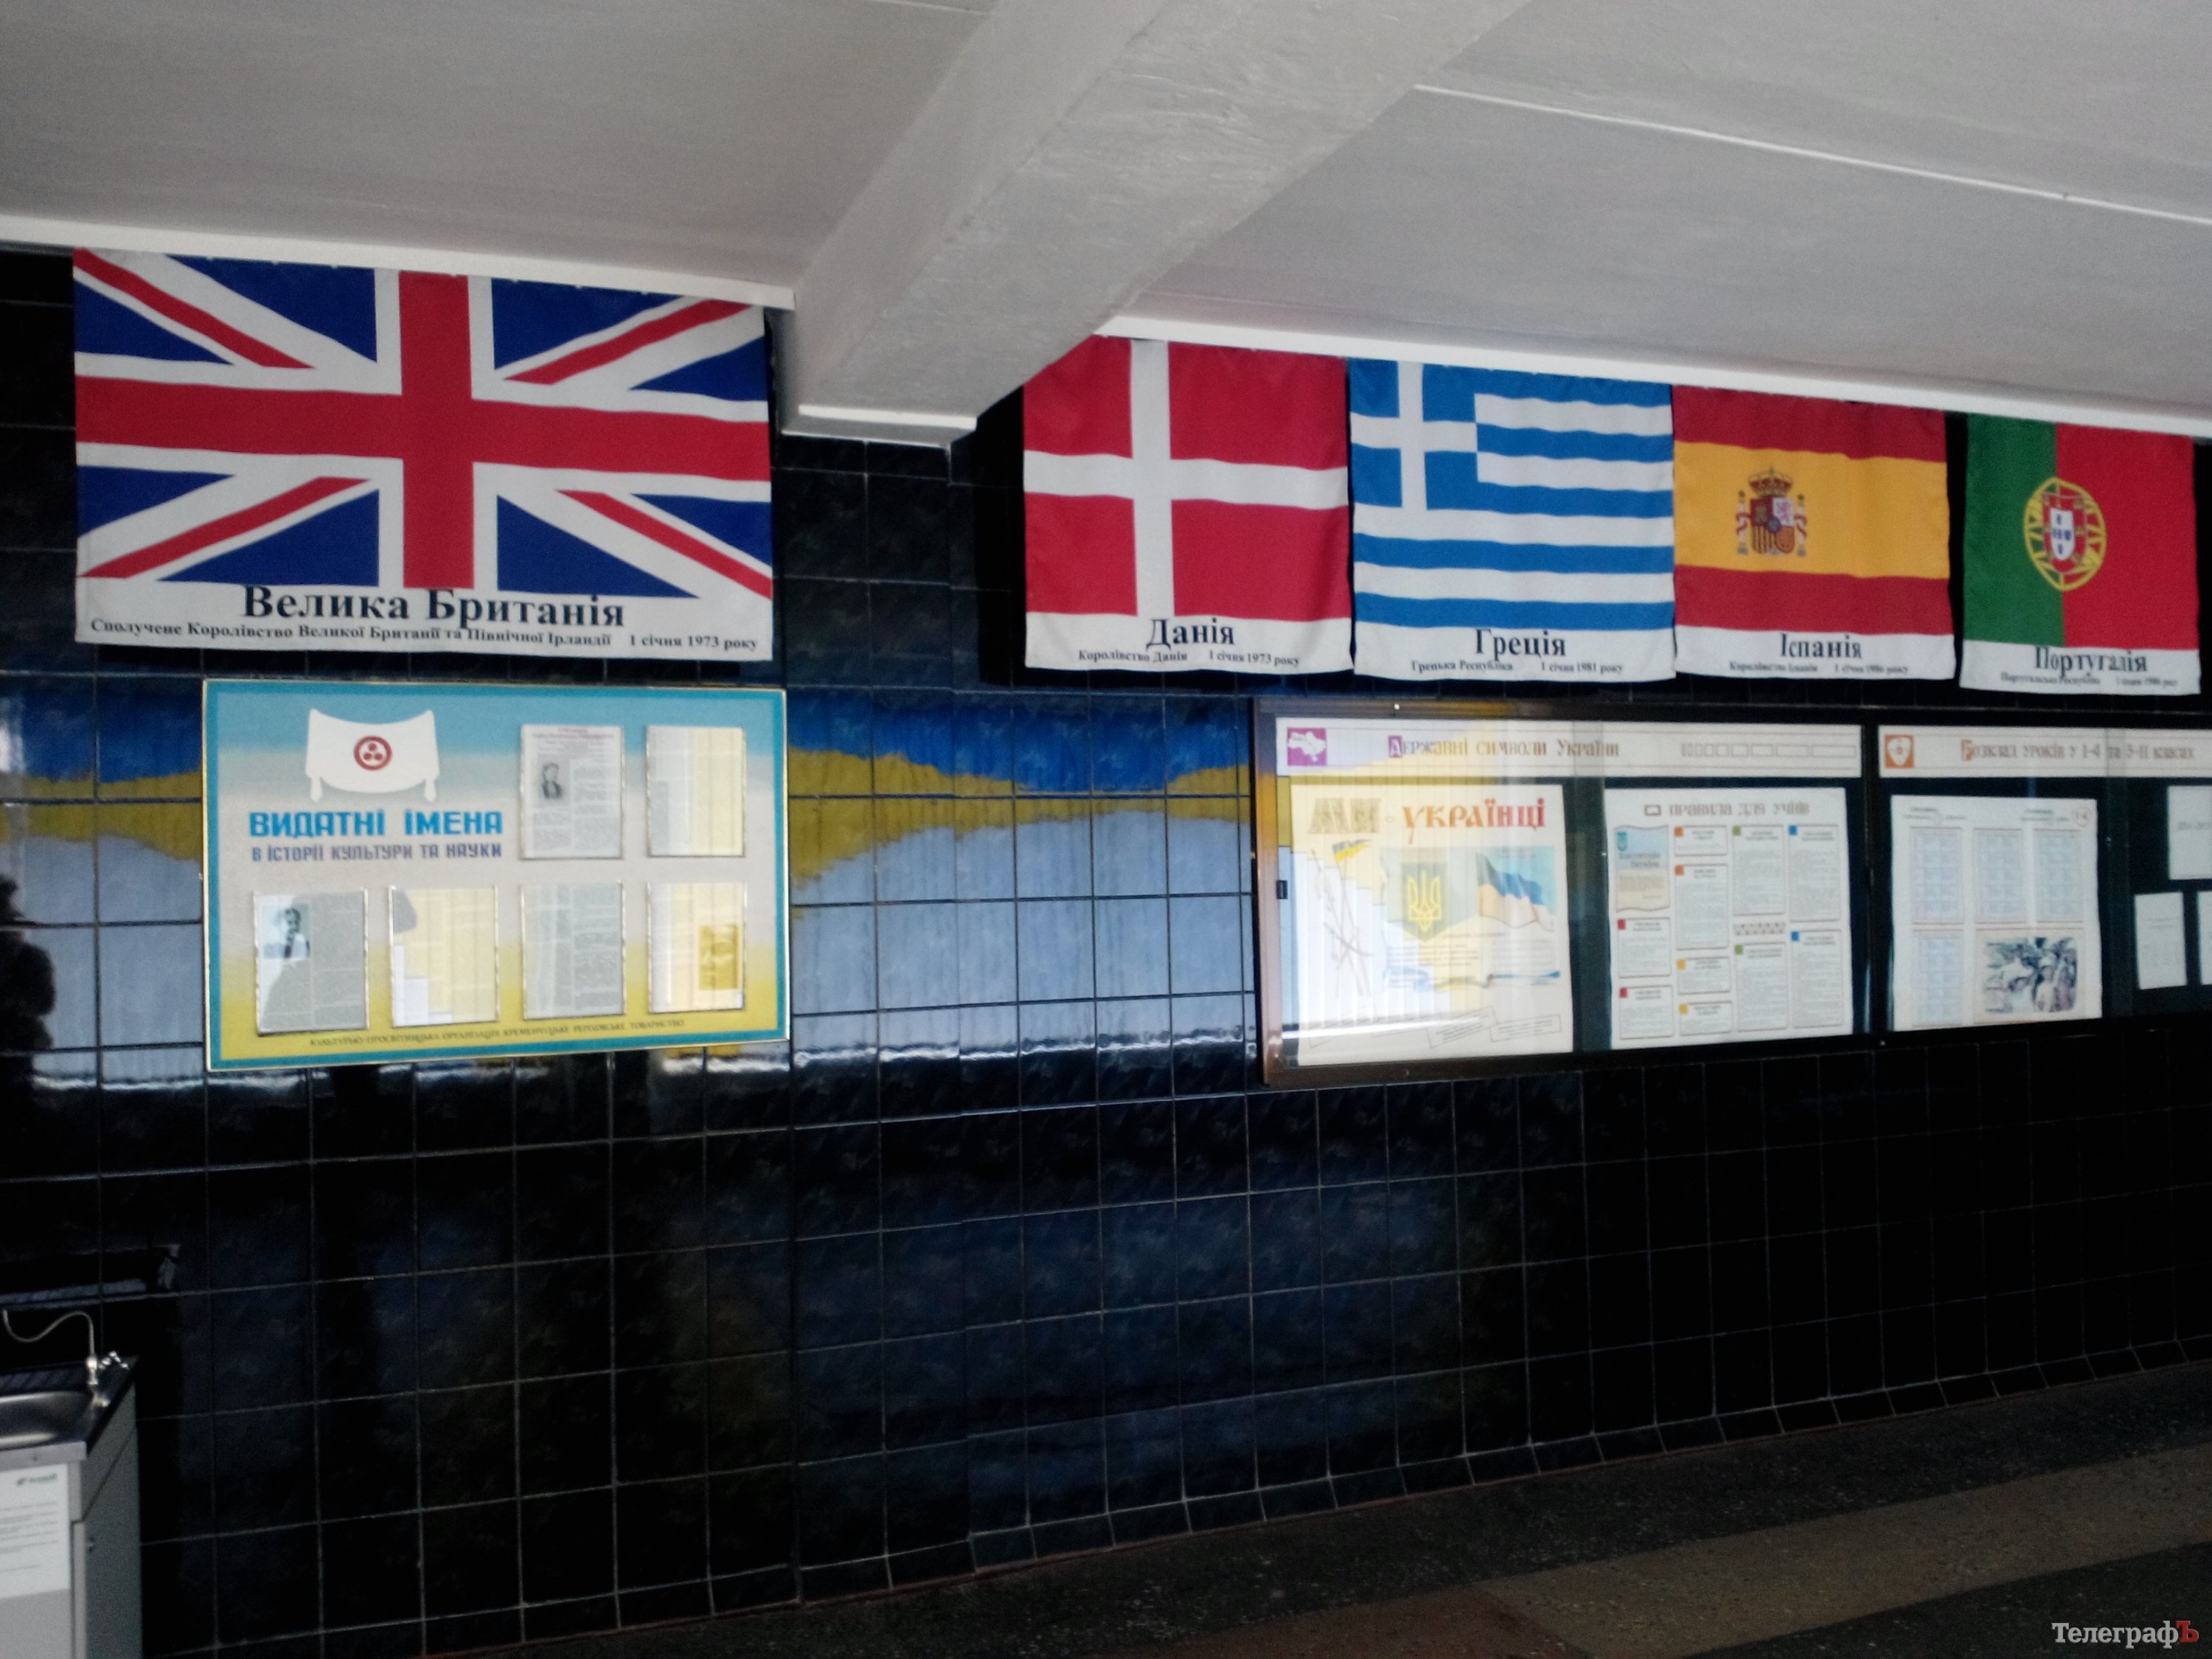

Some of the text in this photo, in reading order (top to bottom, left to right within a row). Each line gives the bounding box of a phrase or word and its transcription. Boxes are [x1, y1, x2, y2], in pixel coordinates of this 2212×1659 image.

[243, 585, 625, 628] Велика Британія
[91, 618, 758, 650] Сполучене Королівство Великої Британії та Північної Ірландії 1 січня 1973 року
[1147, 617, 1235, 650] Данія
[1475, 628, 1566, 661] Греція
[1780, 633, 1863, 659] Іспанія
[1078, 650, 1150, 663] Королівство
[1152, 650, 1188, 663] Данія
[1217, 651, 1245, 663] січня
[1247, 653, 1272, 664] 1973
[1274, 655, 1299, 667] року
[2034, 646, 2147, 676] Португалія
[249, 809, 385, 838] ВИДАТНІ
[405, 809, 504, 835] ІМЕНА
[267, 844, 324, 862] ІСТОРІЇ
[331, 843, 414, 861] КУЛЬТУРИ
[420, 844, 439, 859] ТА
[445, 842, 503, 858] НАУКИ
